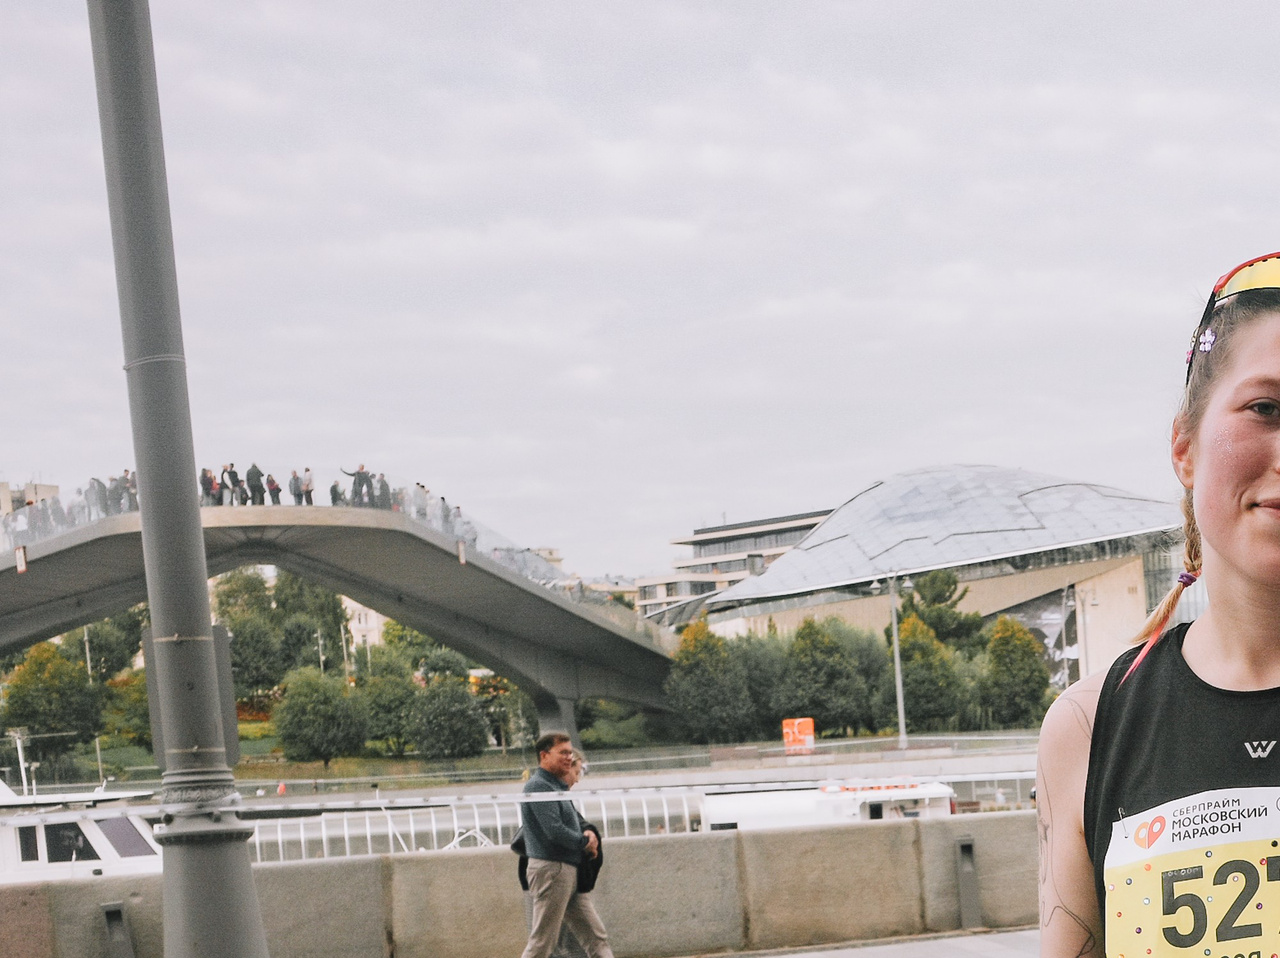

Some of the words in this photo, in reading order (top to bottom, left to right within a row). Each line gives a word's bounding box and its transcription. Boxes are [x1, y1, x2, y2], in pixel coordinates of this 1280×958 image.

[1171, 805, 1269, 830] МОСКОВСКИЙ
[1172, 798, 1241, 818] СБЕРПРАЙМ
[1171, 822, 1242, 843] МАРАФОН
